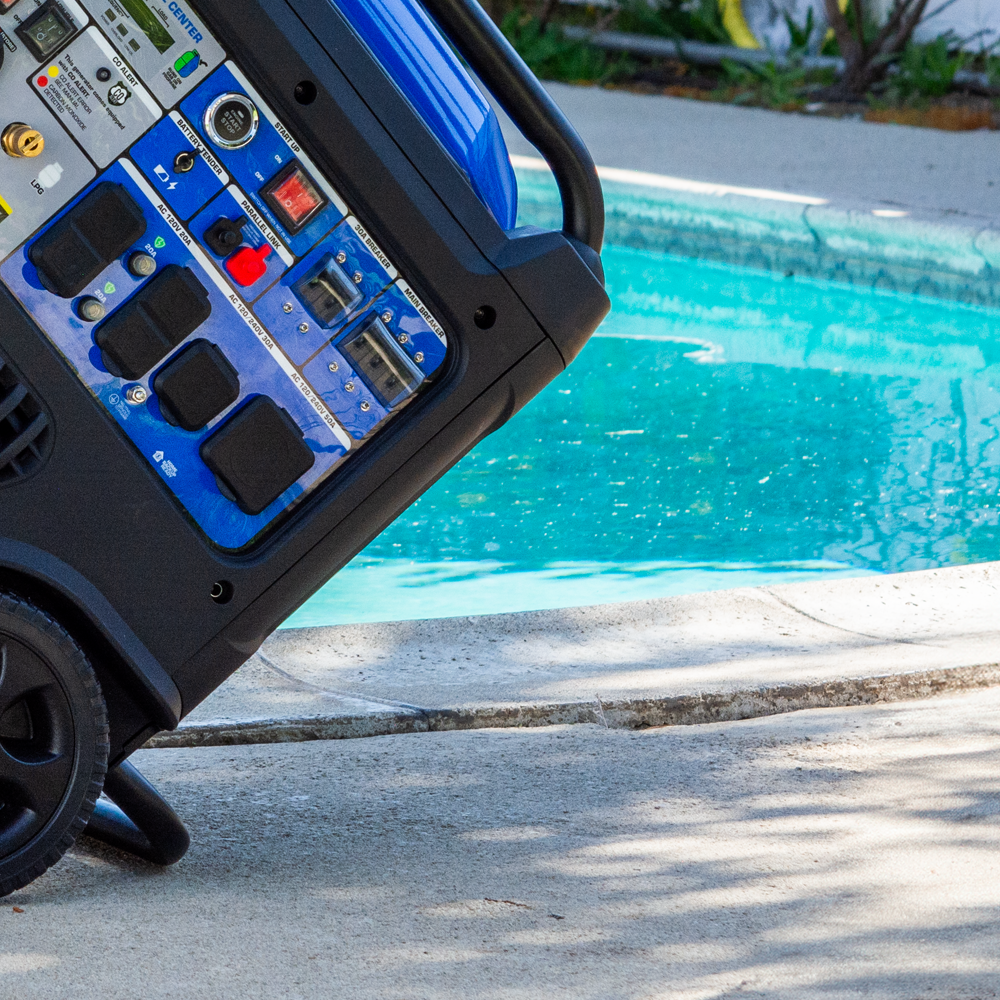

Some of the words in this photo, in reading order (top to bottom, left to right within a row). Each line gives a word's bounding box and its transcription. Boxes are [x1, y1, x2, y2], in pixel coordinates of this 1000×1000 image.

[157, 8, 168, 20] LOAD
[167, 0, 203, 43] CENTER
[58, 59, 69, 72] with
[67, 71, 76, 81] CO
[111, 56, 122, 67] CO
[119, 66, 138, 87] ALERT
[43, 88, 64, 113] DETECTED
[47, 83, 66, 105] CARBON
[64, 103, 86, 130] MONOXIDE
[54, 78, 63, 89] SEE
[61, 87, 79, 109] MANUAL
[58, 74, 67, 83] CO
[64, 81, 78, 98] ALERT
[76, 96, 92, 114] ERROR
[63, 54, 74, 66] This
[71, 65, 94, 92] generator
[92, 90, 106, 107] comes
[104, 106, 125, 130] equipped
[112, 87, 125, 100] CO
[220, 117, 235, 135] STOP
[223, 110, 241, 132] START
[230, 109, 243, 125] ENGINE
[176, 118, 202, 148] BATTERY
[199, 147, 223, 175] TENDER
[274, 121, 293, 144] START
[289, 142, 300, 153] UP
[273, 154, 283, 164] ON
[30, 179, 44, 195] LPG
[253, 170, 264, 182] OFF
[156, 203, 167, 215] AC
[164, 213, 181, 232] 120V
[178, 230, 192, 246] 20A
[240, 200, 268, 233] PARALLEL
[265, 231, 281, 249] LINK
[144, 243, 157, 258] 20A
[353, 223, 367, 239] 30A
[364, 237, 391, 269] BREAKER
[94, 288, 107, 303] 20A
[228, 293, 238, 304] AC
[235, 302, 264, 337] 120/240V
[260, 334, 274, 350] 30A
[403, 287, 421, 308] MAIN
[417, 306, 445, 338] BREAKER
[290, 372, 300, 383] AC
[297, 381, 326, 415] 120/240V
[323, 413, 336, 428] 50A
